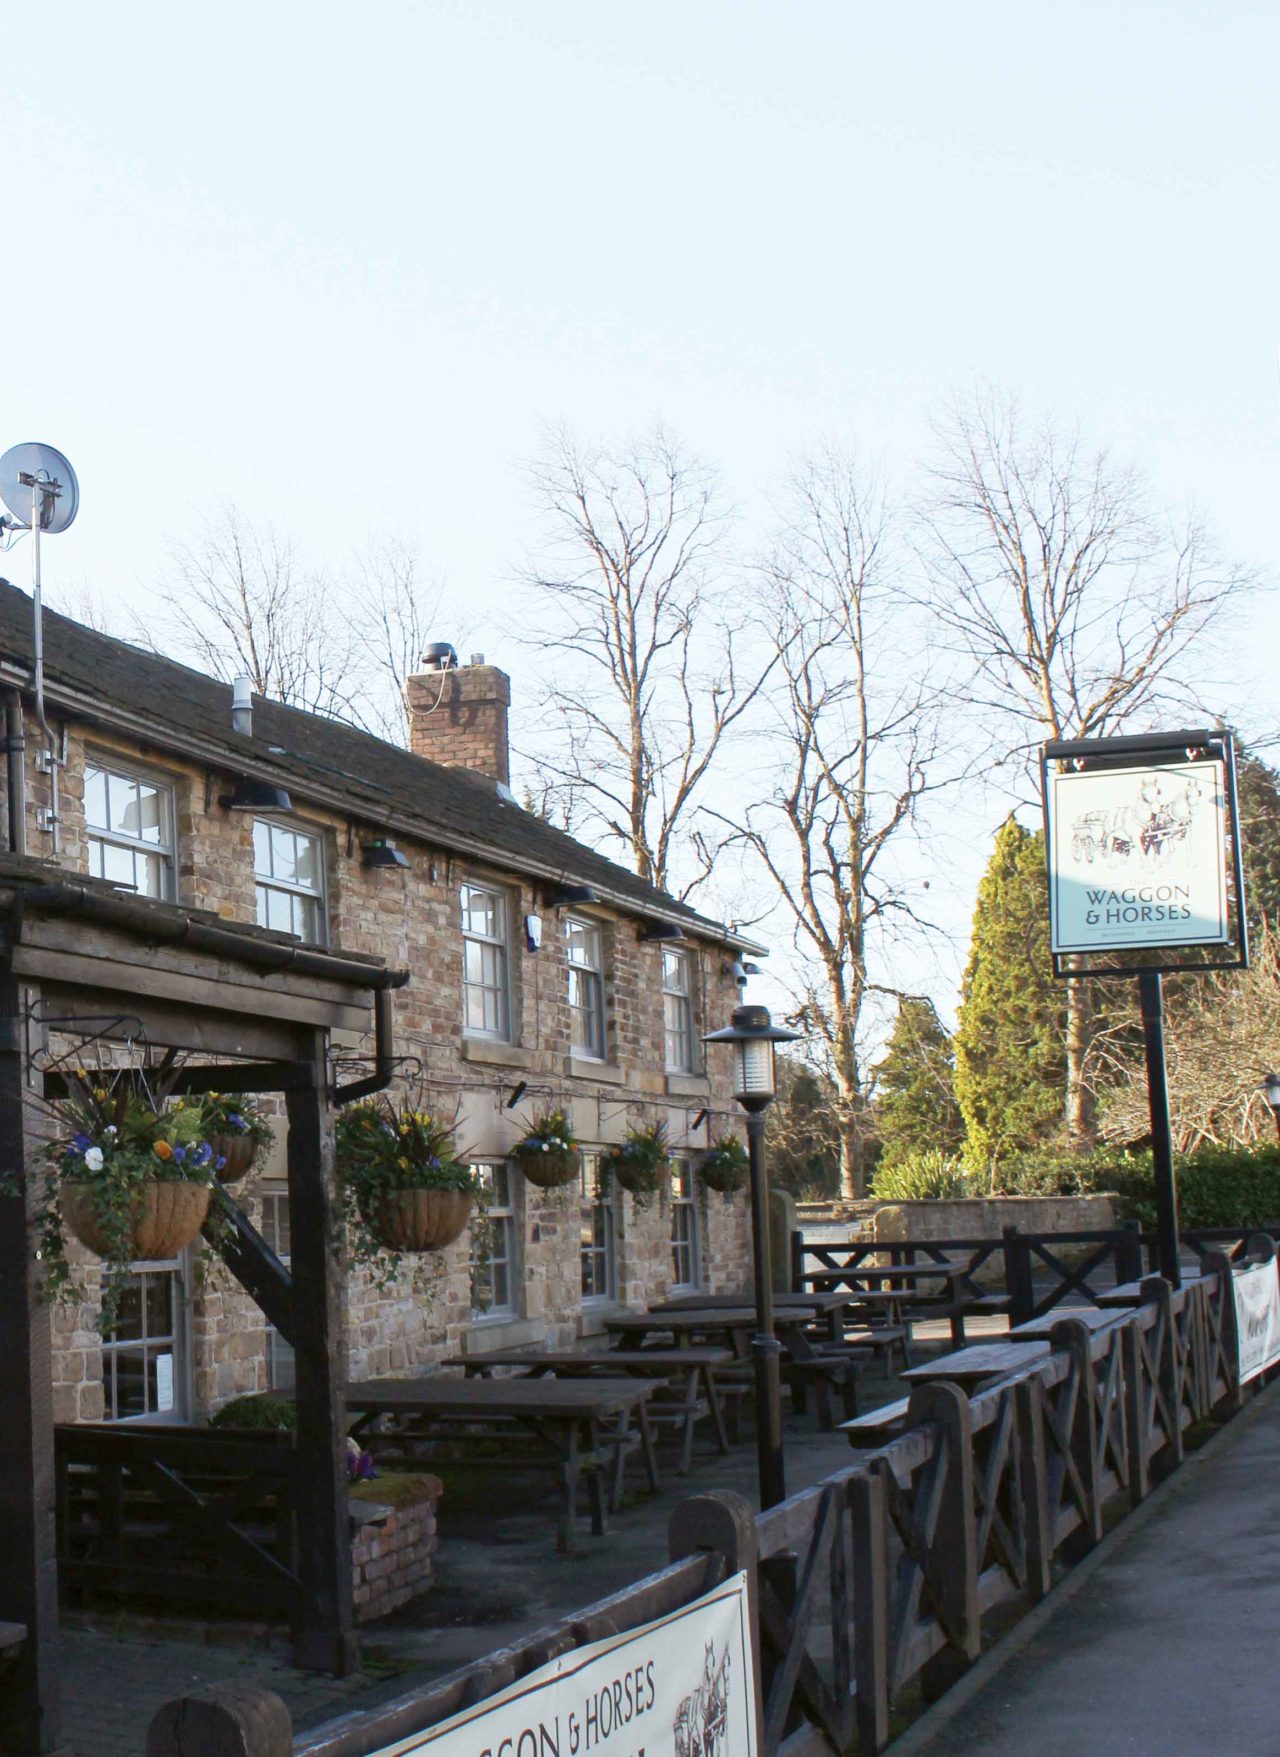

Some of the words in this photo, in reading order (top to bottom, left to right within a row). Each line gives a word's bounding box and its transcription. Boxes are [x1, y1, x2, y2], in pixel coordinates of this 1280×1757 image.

[1086, 884, 1190, 905] WAGGON
[1085, 910, 1101, 925] &
[1106, 903, 1191, 924] HORSES
[569, 1712, 580, 1755] &
[586, 1660, 655, 1750] HORSES
